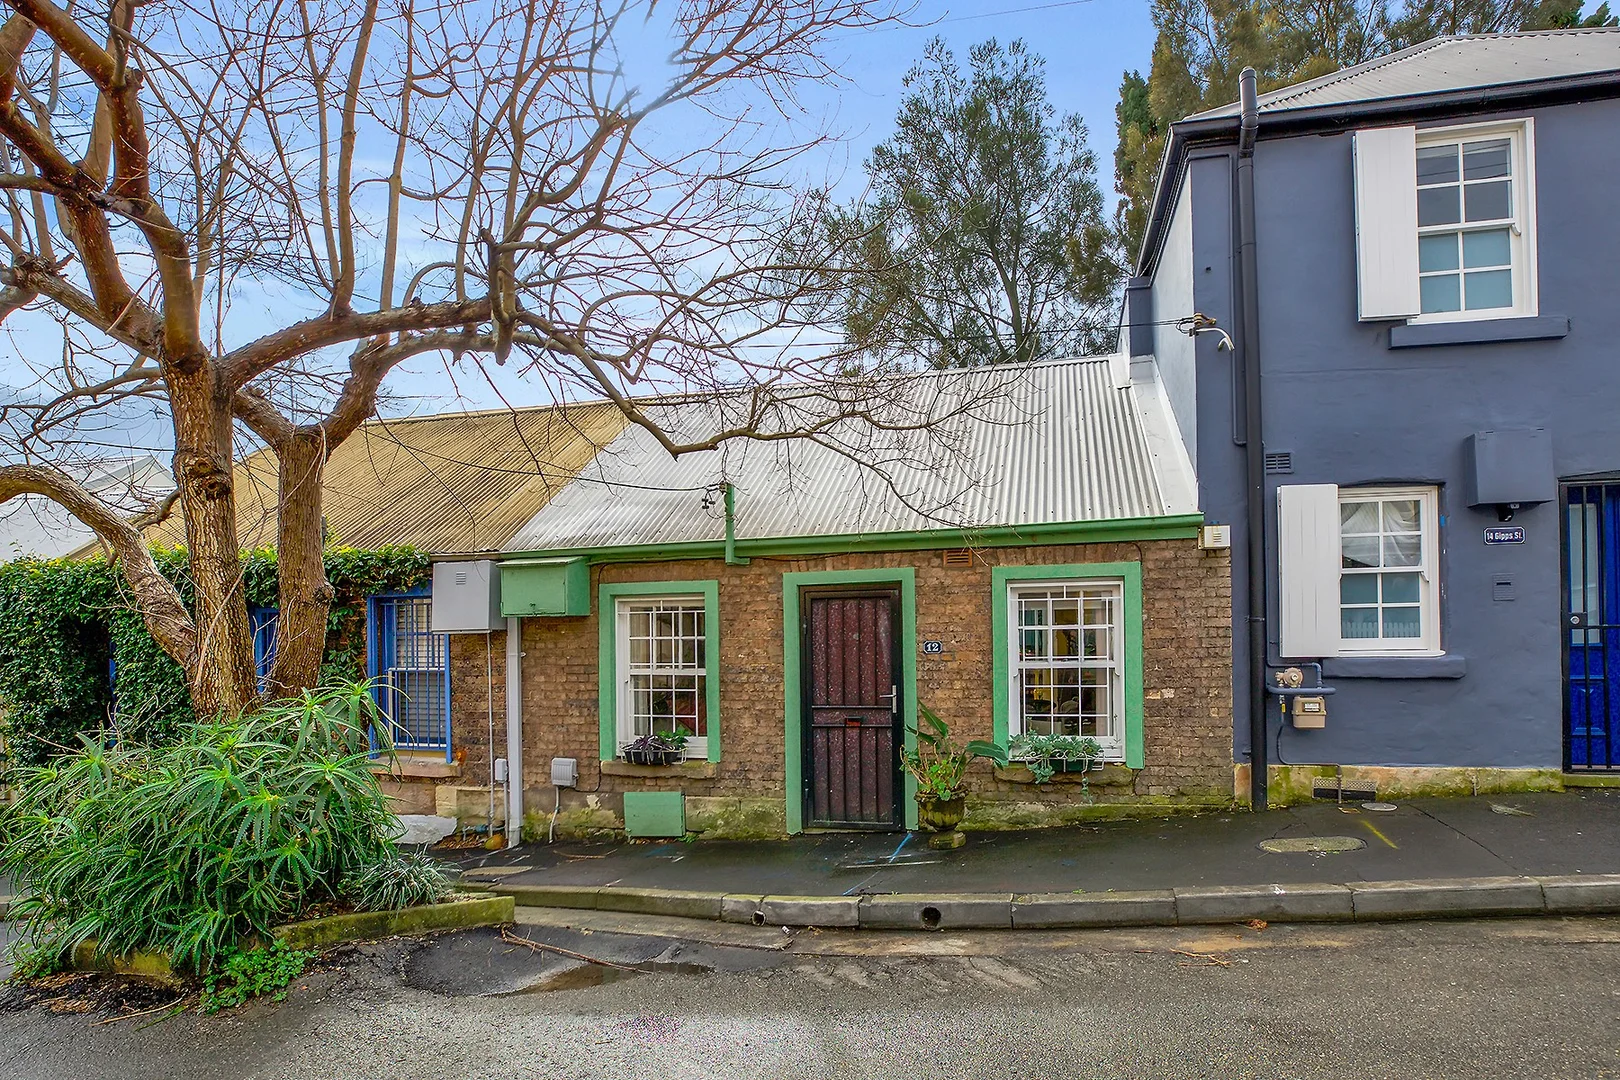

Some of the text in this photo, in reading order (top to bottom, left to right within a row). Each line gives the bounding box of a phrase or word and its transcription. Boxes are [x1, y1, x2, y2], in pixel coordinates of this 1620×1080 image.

[1486, 532, 1494, 540] 14
[1494, 531, 1514, 541] Gipps
[926, 642, 939, 652] 12
